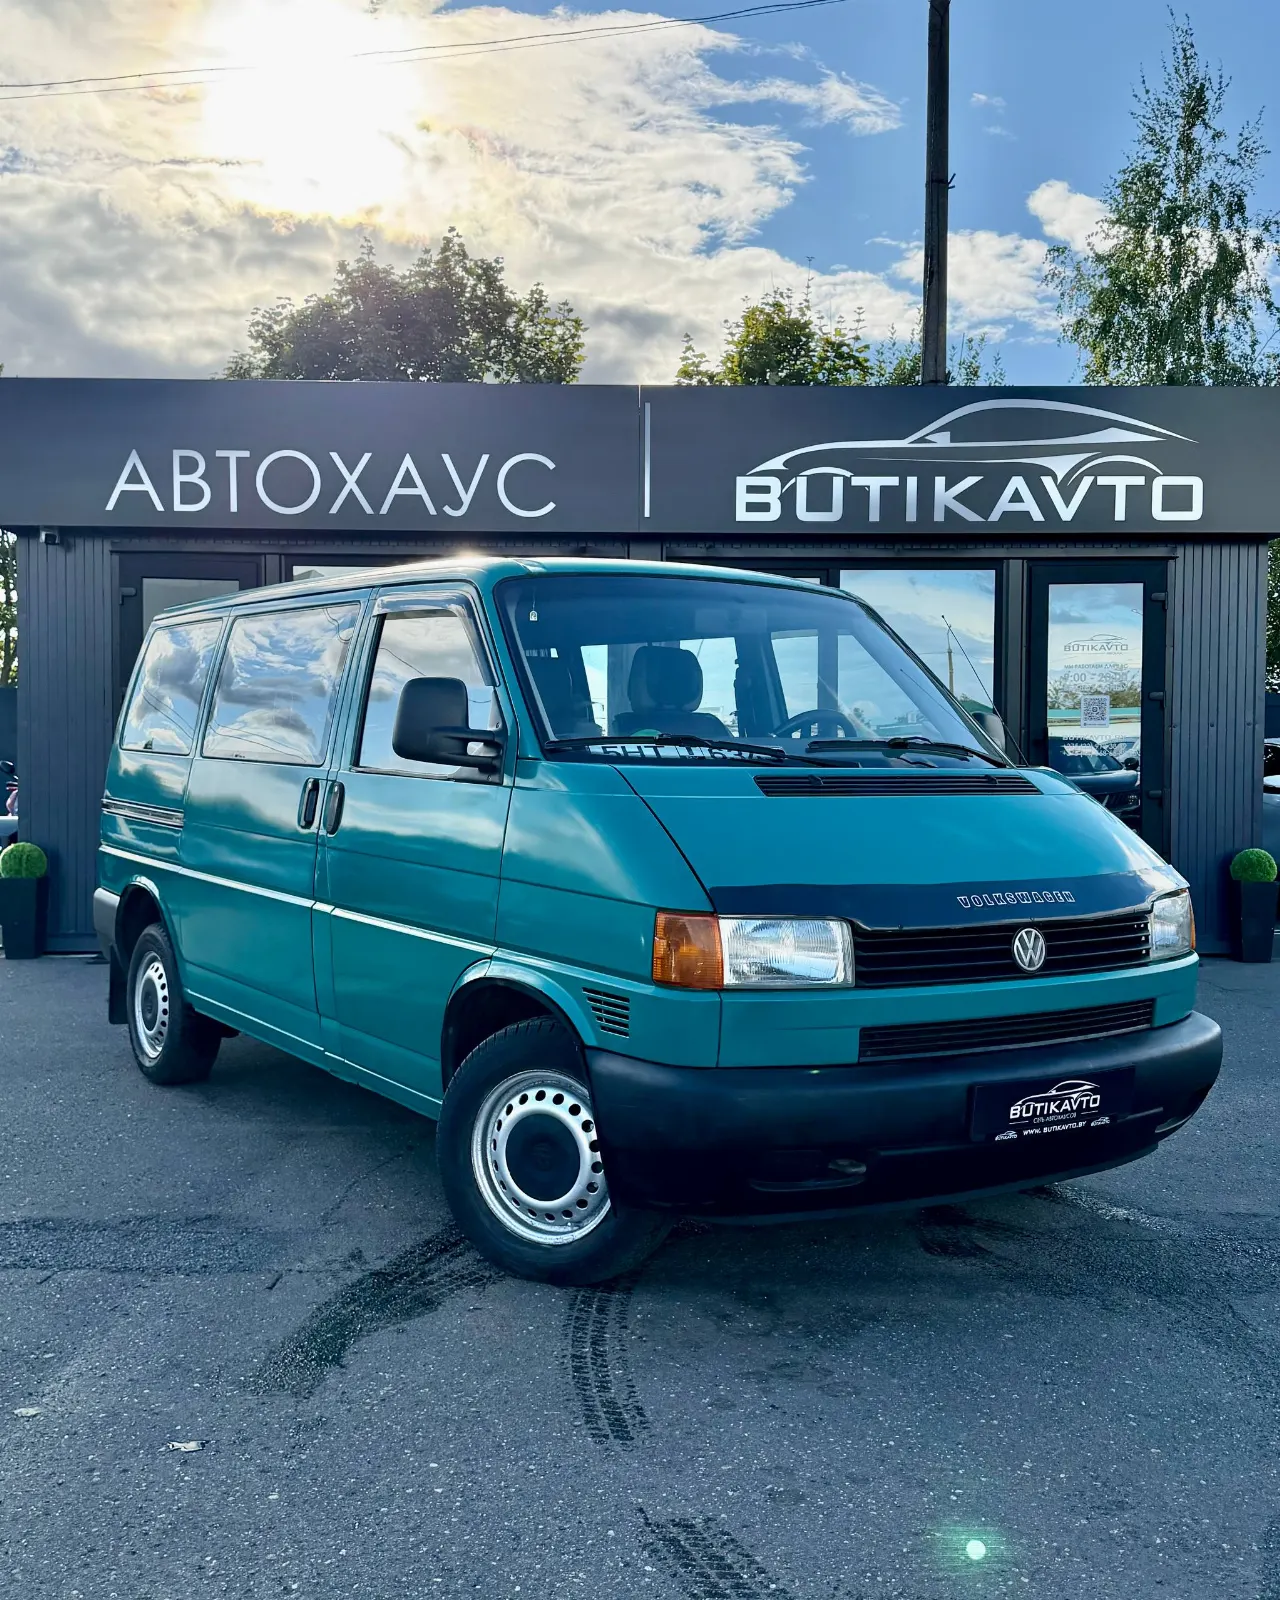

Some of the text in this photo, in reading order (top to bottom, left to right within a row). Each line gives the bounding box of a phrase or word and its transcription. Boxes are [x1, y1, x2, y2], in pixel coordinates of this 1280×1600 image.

[105, 448, 557, 518] АВТОХАУС
[735, 474, 1204, 522] BUTIKAVTO
[1063, 644, 1129, 652] BUTIKAVTO
[956, 890, 1076, 908] VOLKSWAGEN
[1009, 1095, 1101, 1119] BUTIKAVTO
